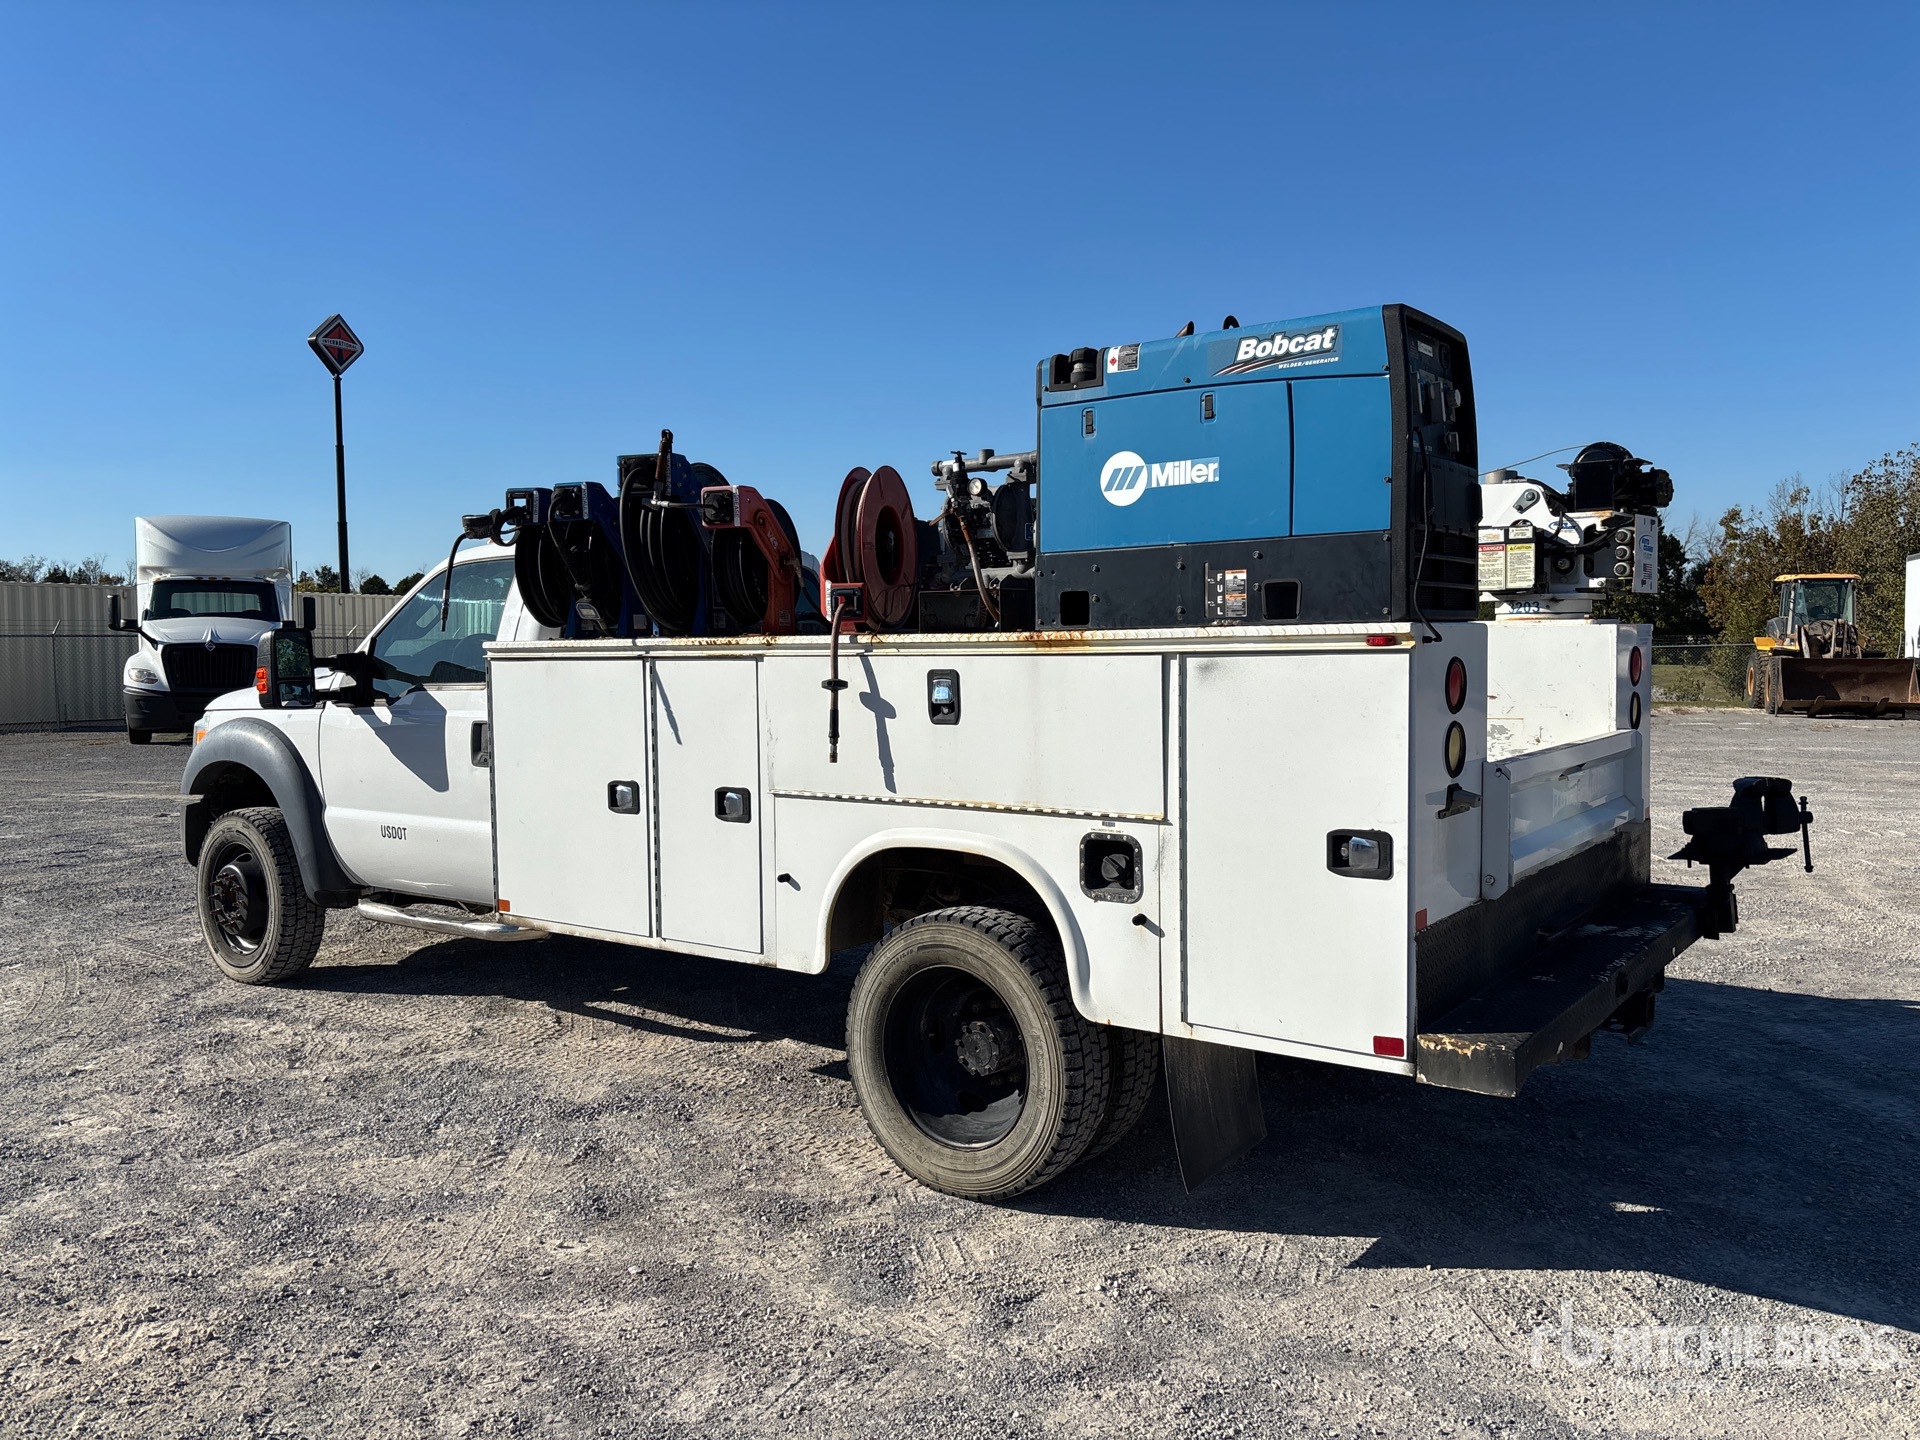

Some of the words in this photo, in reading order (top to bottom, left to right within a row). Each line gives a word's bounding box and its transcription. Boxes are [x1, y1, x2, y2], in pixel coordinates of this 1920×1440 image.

[1236, 327, 1336, 361] Bobcat
[1278, 356, 1339, 369] WELDER/GENERATOR
[1151, 460, 1218, 488] Miller
[380, 824, 407, 840] USDOT
